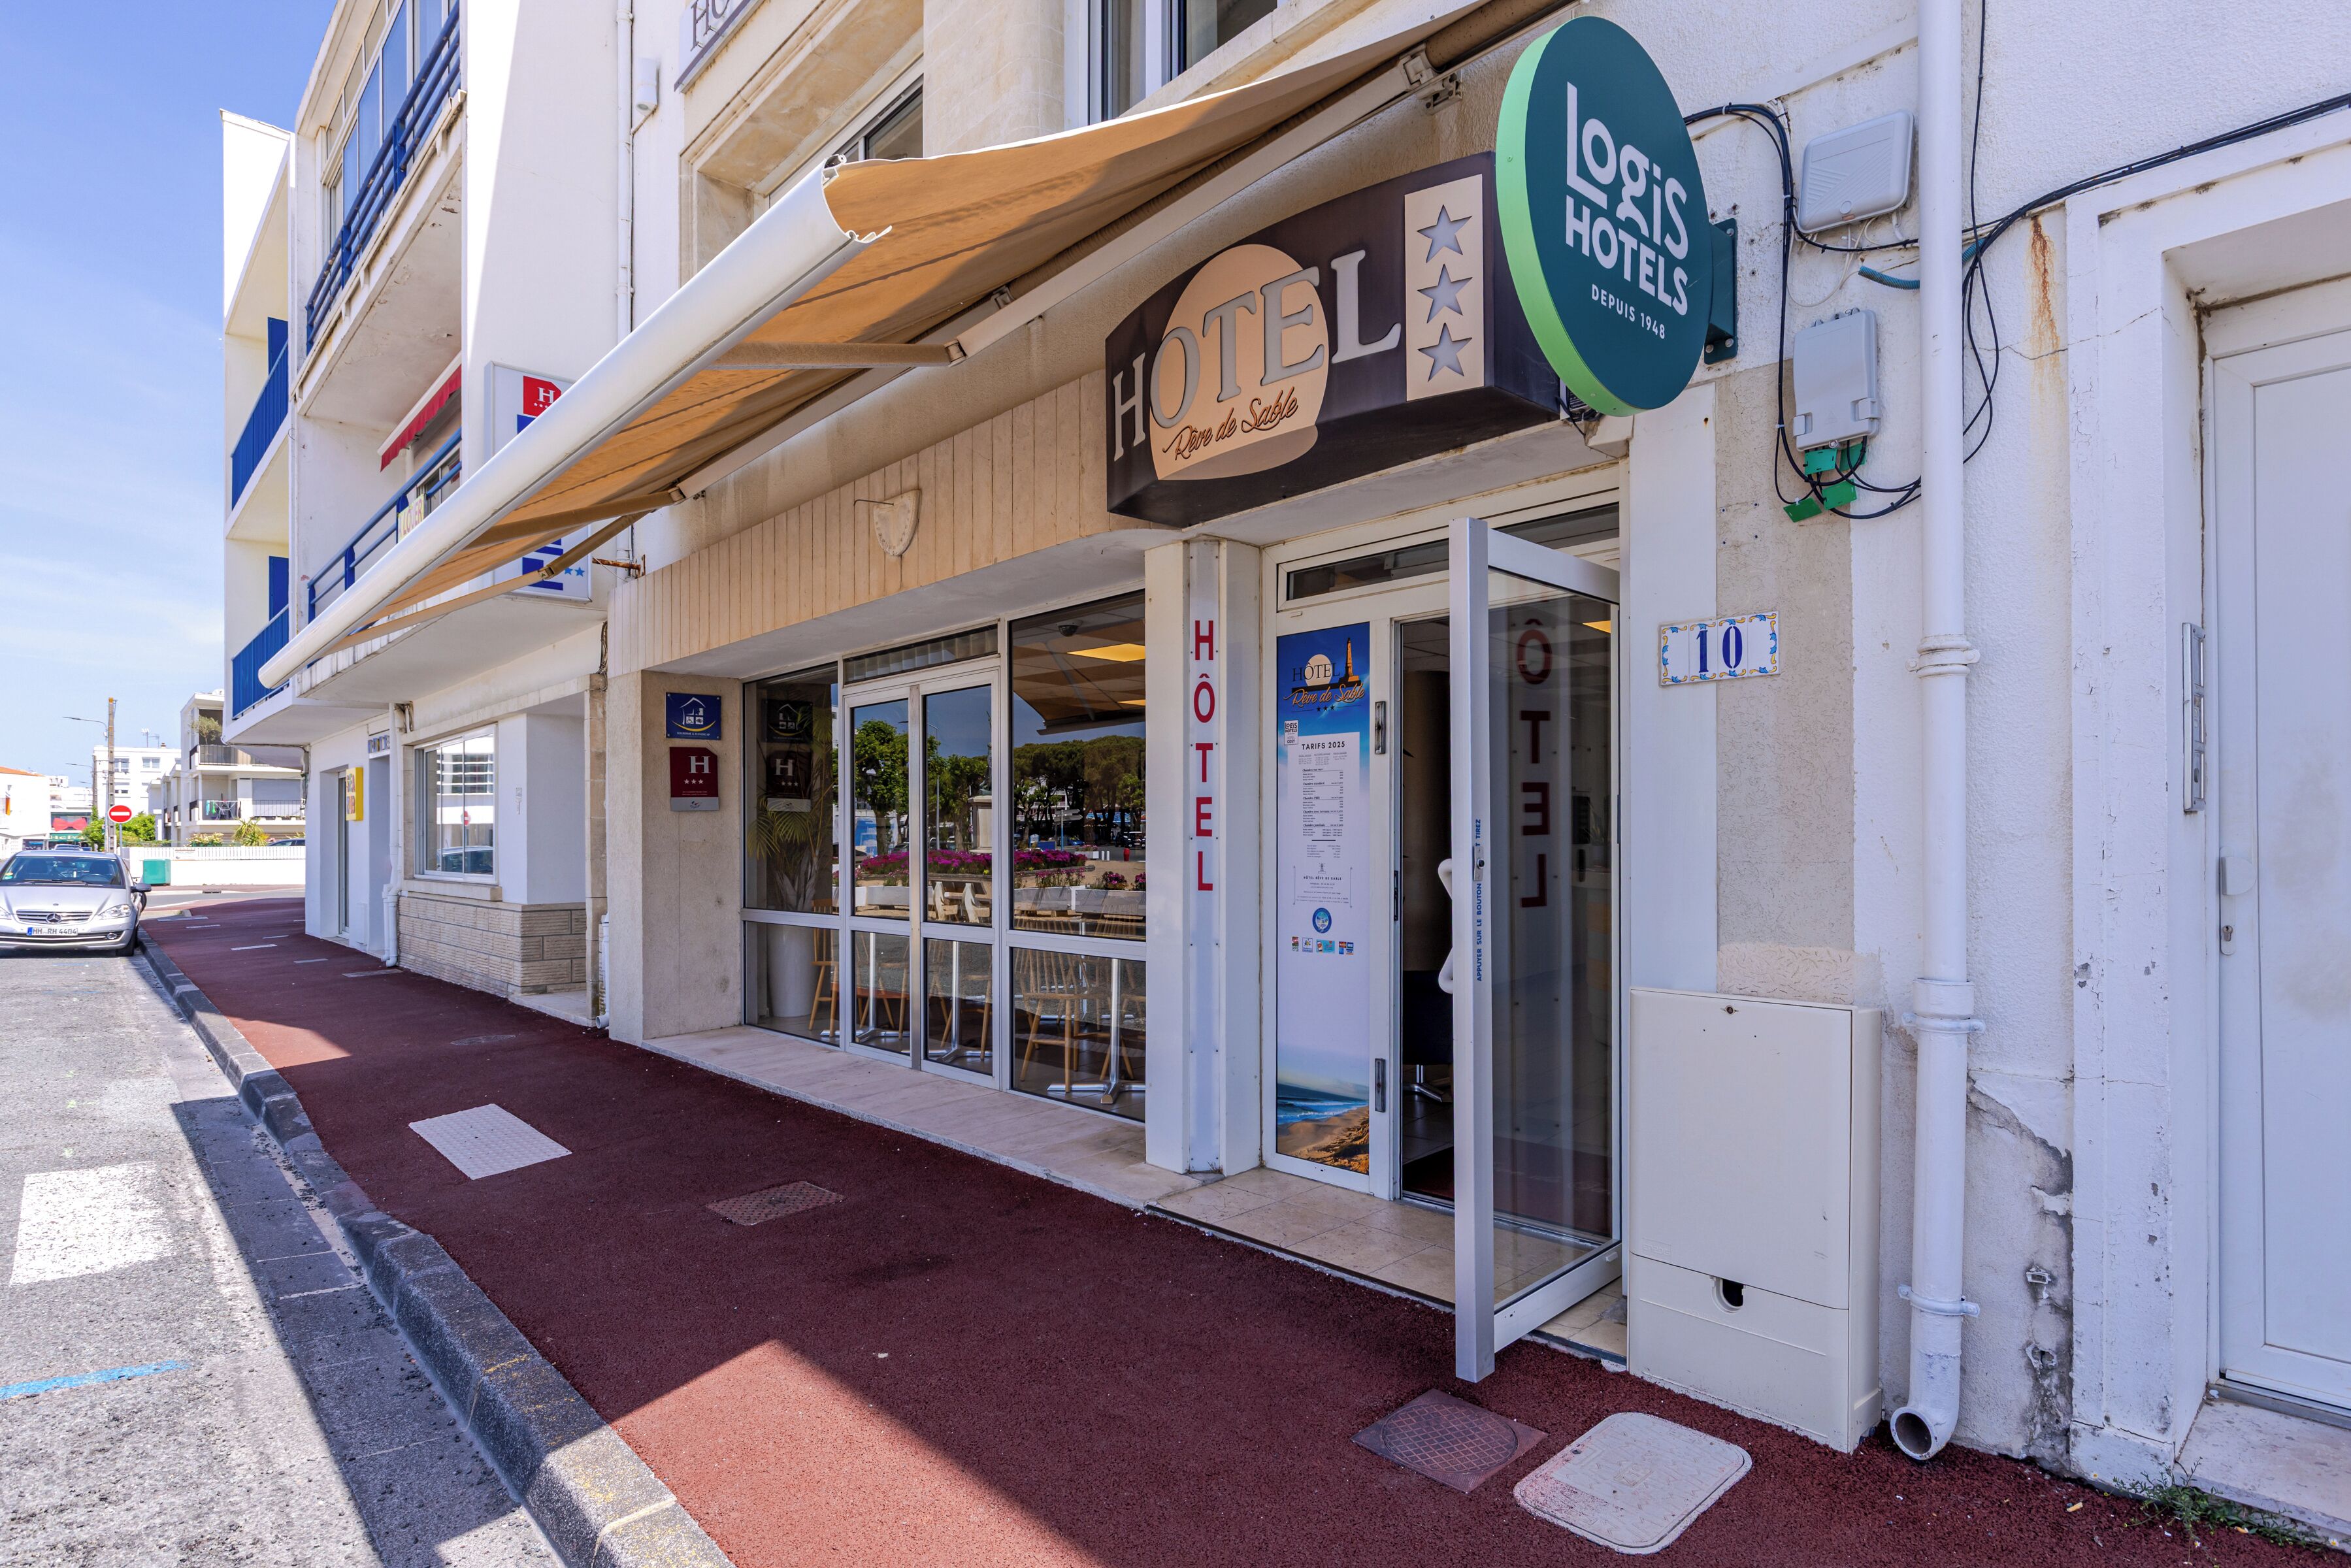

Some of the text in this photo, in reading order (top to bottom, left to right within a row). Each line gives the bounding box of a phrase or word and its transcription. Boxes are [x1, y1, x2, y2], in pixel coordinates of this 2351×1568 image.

[1566, 195, 1688, 316] HOTELS
[1592, 284, 1666, 339] DEPUIS 1948
[1113, 250, 1402, 461] HOTEL
[537, 387, 555, 404] H
[1162, 386, 1299, 461] Rêve de Sable
[1292, 661, 1341, 682] HÔTEL
[1696, 625, 1743, 673] 10
[1319, 686, 1332, 703] de
[1334, 681, 1365, 704] Sable
[689, 755, 711, 774] H
[1193, 620, 1215, 891] HÔTEL
[1477, 918, 1482, 926] LE
